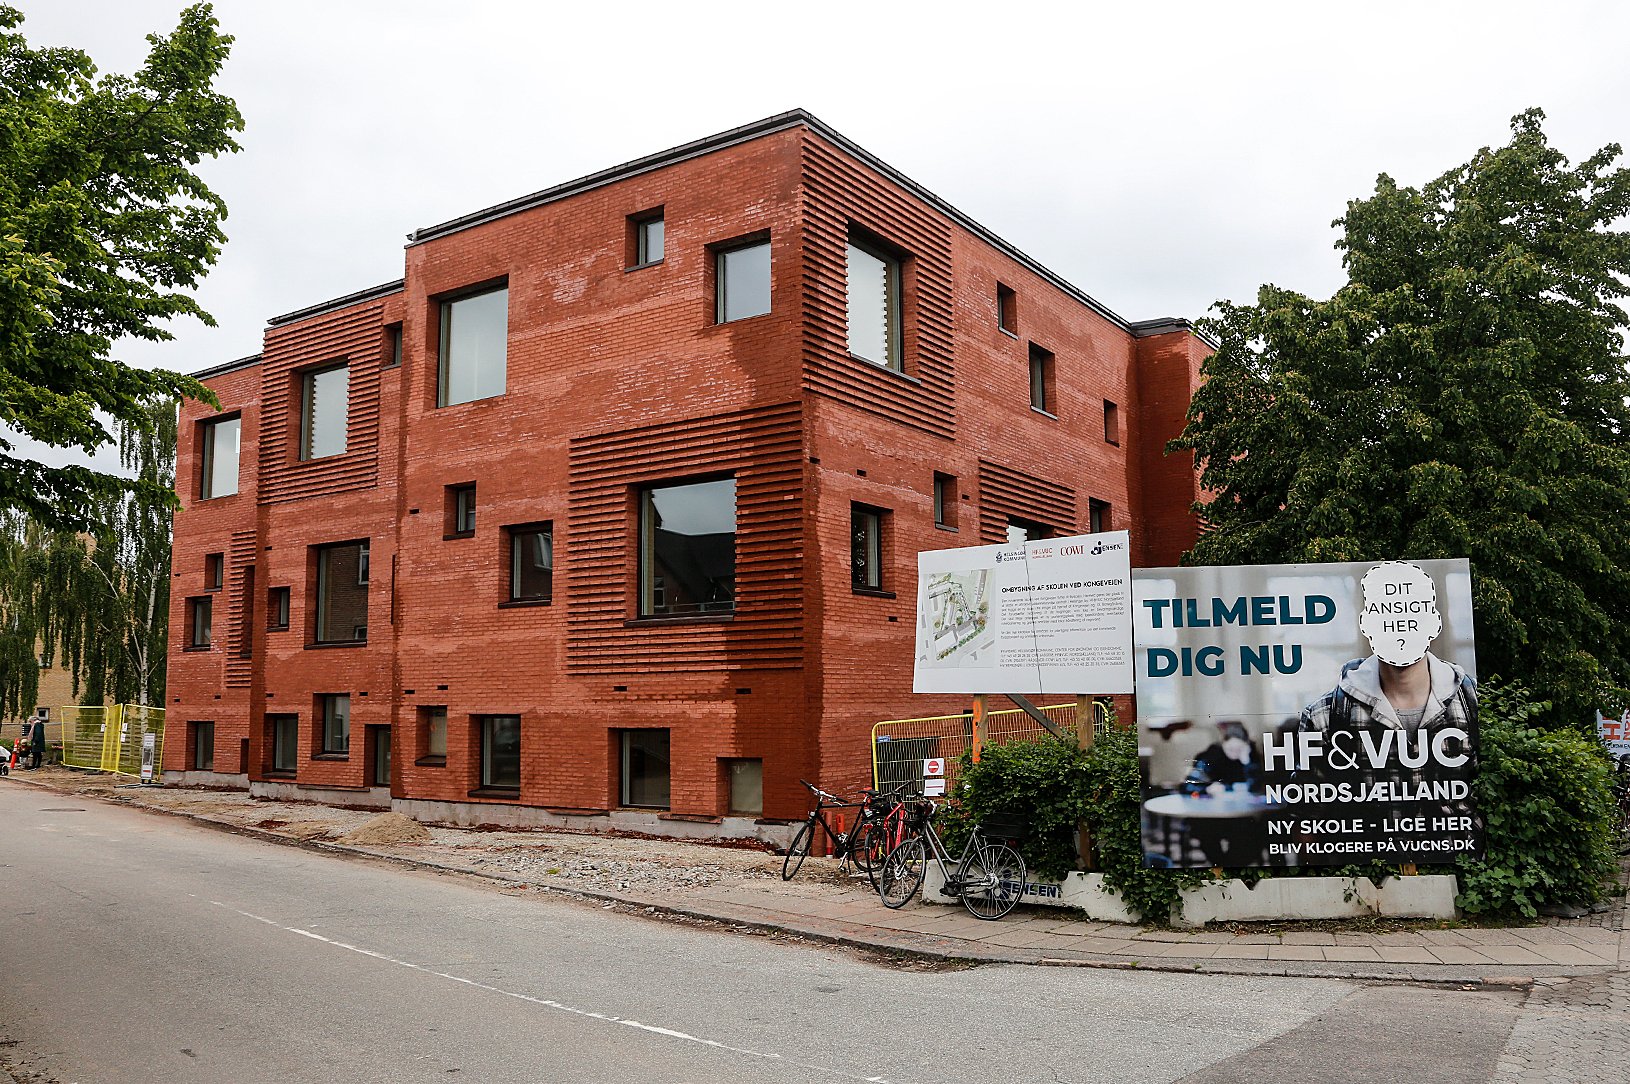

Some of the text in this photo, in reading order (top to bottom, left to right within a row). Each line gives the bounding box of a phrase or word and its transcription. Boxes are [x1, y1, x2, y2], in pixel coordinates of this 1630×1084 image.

[1060, 545, 1085, 556] COWI
[1001, 578, 1123, 594] OMBYGNING AF SKOLEN VED KONGEVEJEN
[1385, 582, 1413, 596] DIT
[1143, 594, 1337, 629] TILMELD
[1368, 600, 1431, 615] ANSIGT
[1383, 620, 1418, 633] HER
[1396, 638, 1406, 651] ?
[1147, 644, 1303, 678] DIG NU
[1262, 727, 1470, 772] HF&VUC
[1265, 780, 1469, 804] NORDSJÆLLAND
[1267, 820, 1295, 835] NY
[1300, 818, 1364, 834] SKOLE
[1383, 817, 1427, 833] LIGE
[1432, 816, 1473, 832] HER
[1269, 837, 1476, 855] BLIV KLOGERE PÅ VUCNS.DK
